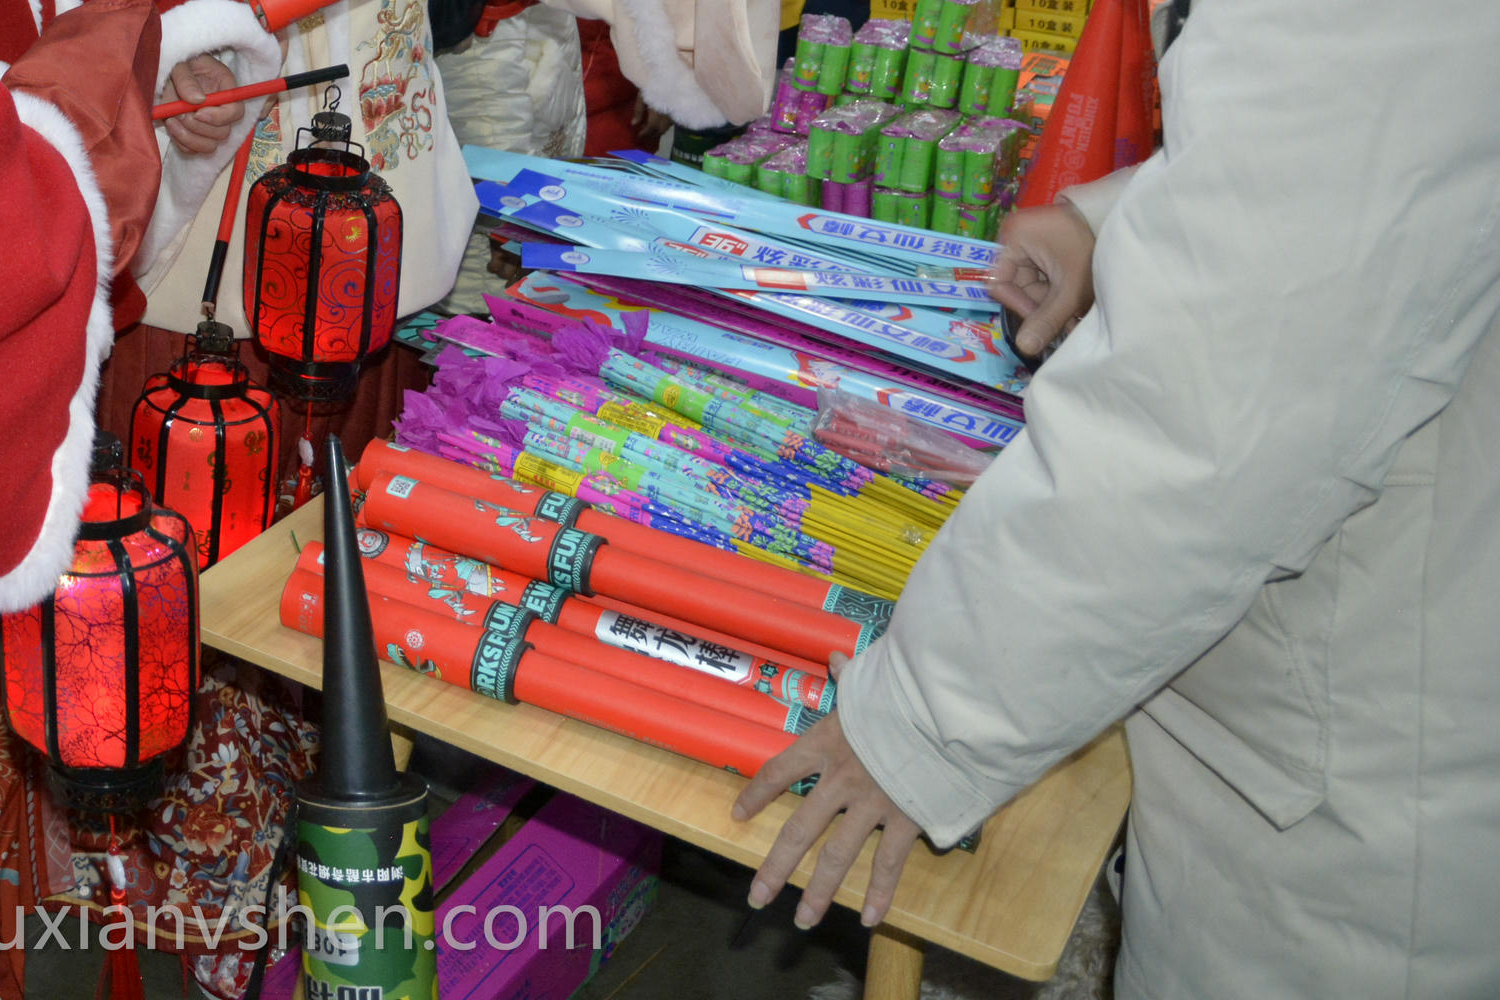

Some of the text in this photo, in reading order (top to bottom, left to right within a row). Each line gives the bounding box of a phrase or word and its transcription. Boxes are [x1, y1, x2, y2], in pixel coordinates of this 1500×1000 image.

[882, 0, 917, 11] 10盒
[1029, 18, 1073, 33] 10盒装
[297, 854, 404, 883] 浏阳市酷奇烟花
